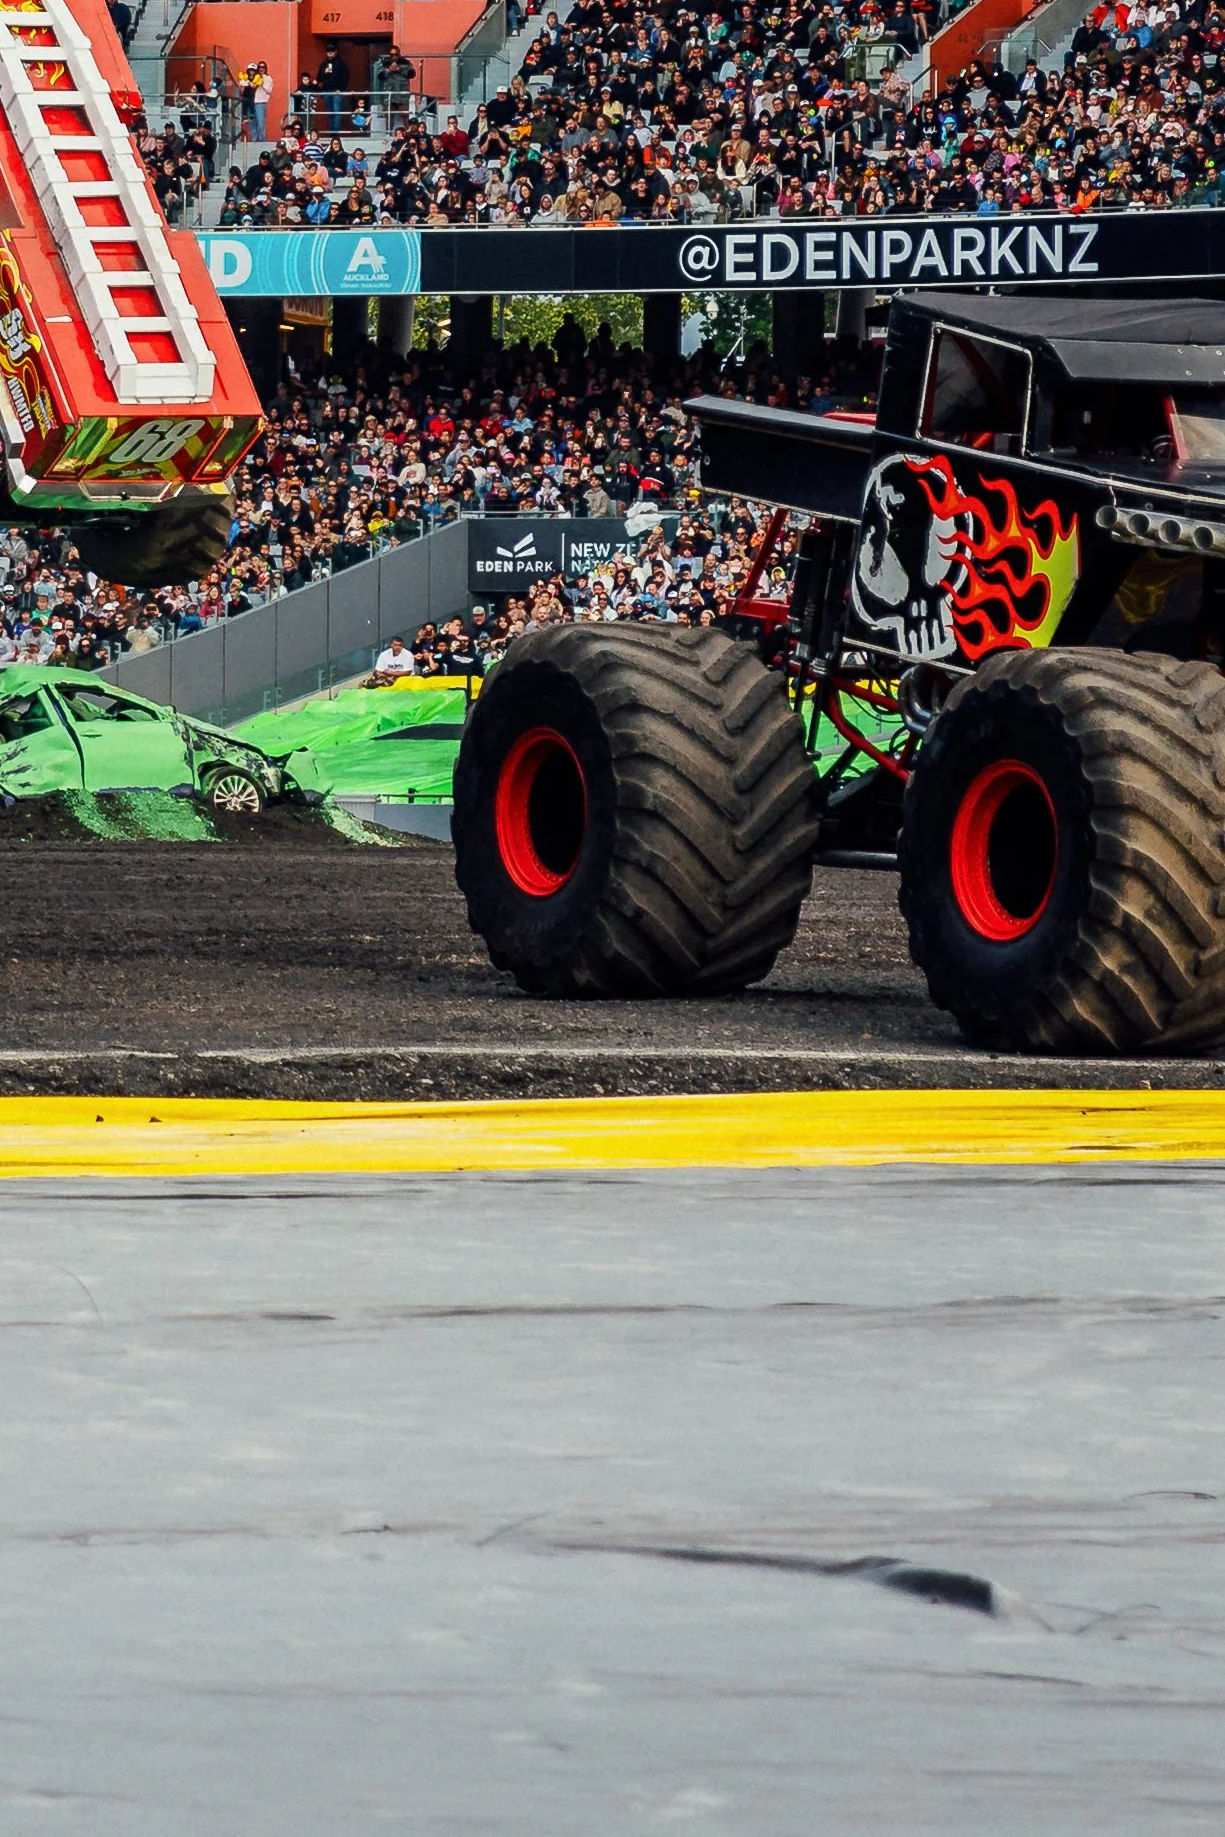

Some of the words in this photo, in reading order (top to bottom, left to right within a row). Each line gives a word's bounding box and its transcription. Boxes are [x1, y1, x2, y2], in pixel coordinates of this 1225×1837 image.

[322, 12, 342, 22] 417
[376, 11, 395, 21] 418
[679, 223, 1099, 282] @EDENPARKNZ
[109, 419, 206, 462] 68
[571, 542, 611, 557] NEW
[476, 561, 513, 572] EDEN
[517, 561, 553, 572] PARK
